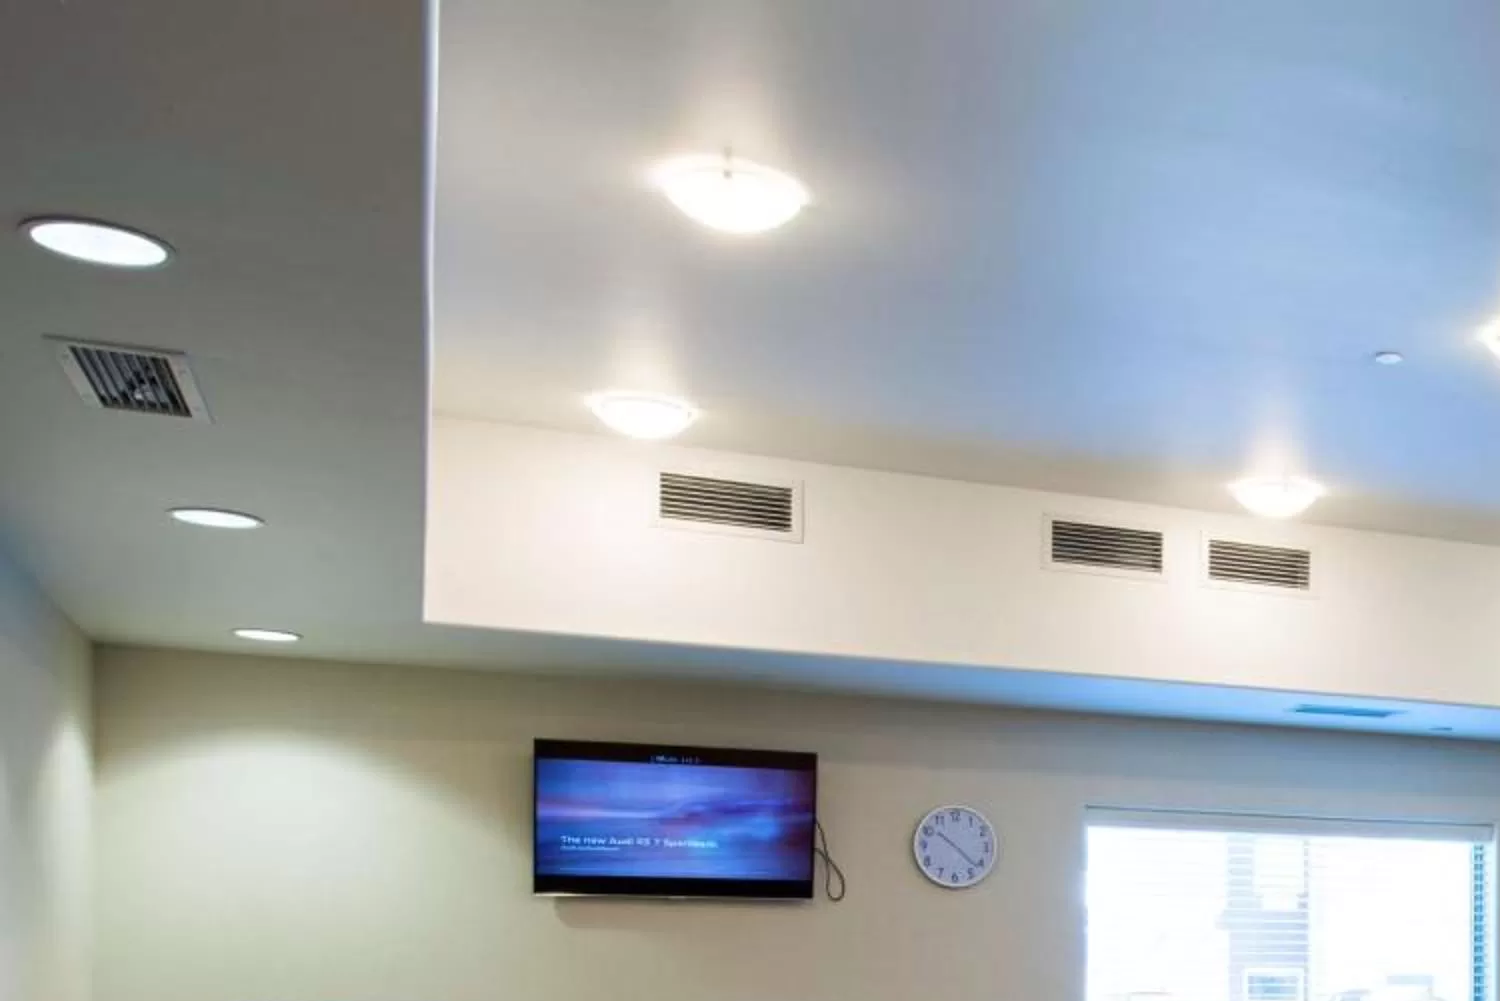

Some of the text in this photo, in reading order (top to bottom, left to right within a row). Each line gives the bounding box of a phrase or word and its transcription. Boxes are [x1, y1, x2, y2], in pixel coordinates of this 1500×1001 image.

[949, 811, 961, 822] 12
[922, 825, 935, 837] 10
[560, 835, 581, 845] The
[608, 836, 635, 846] Audi
